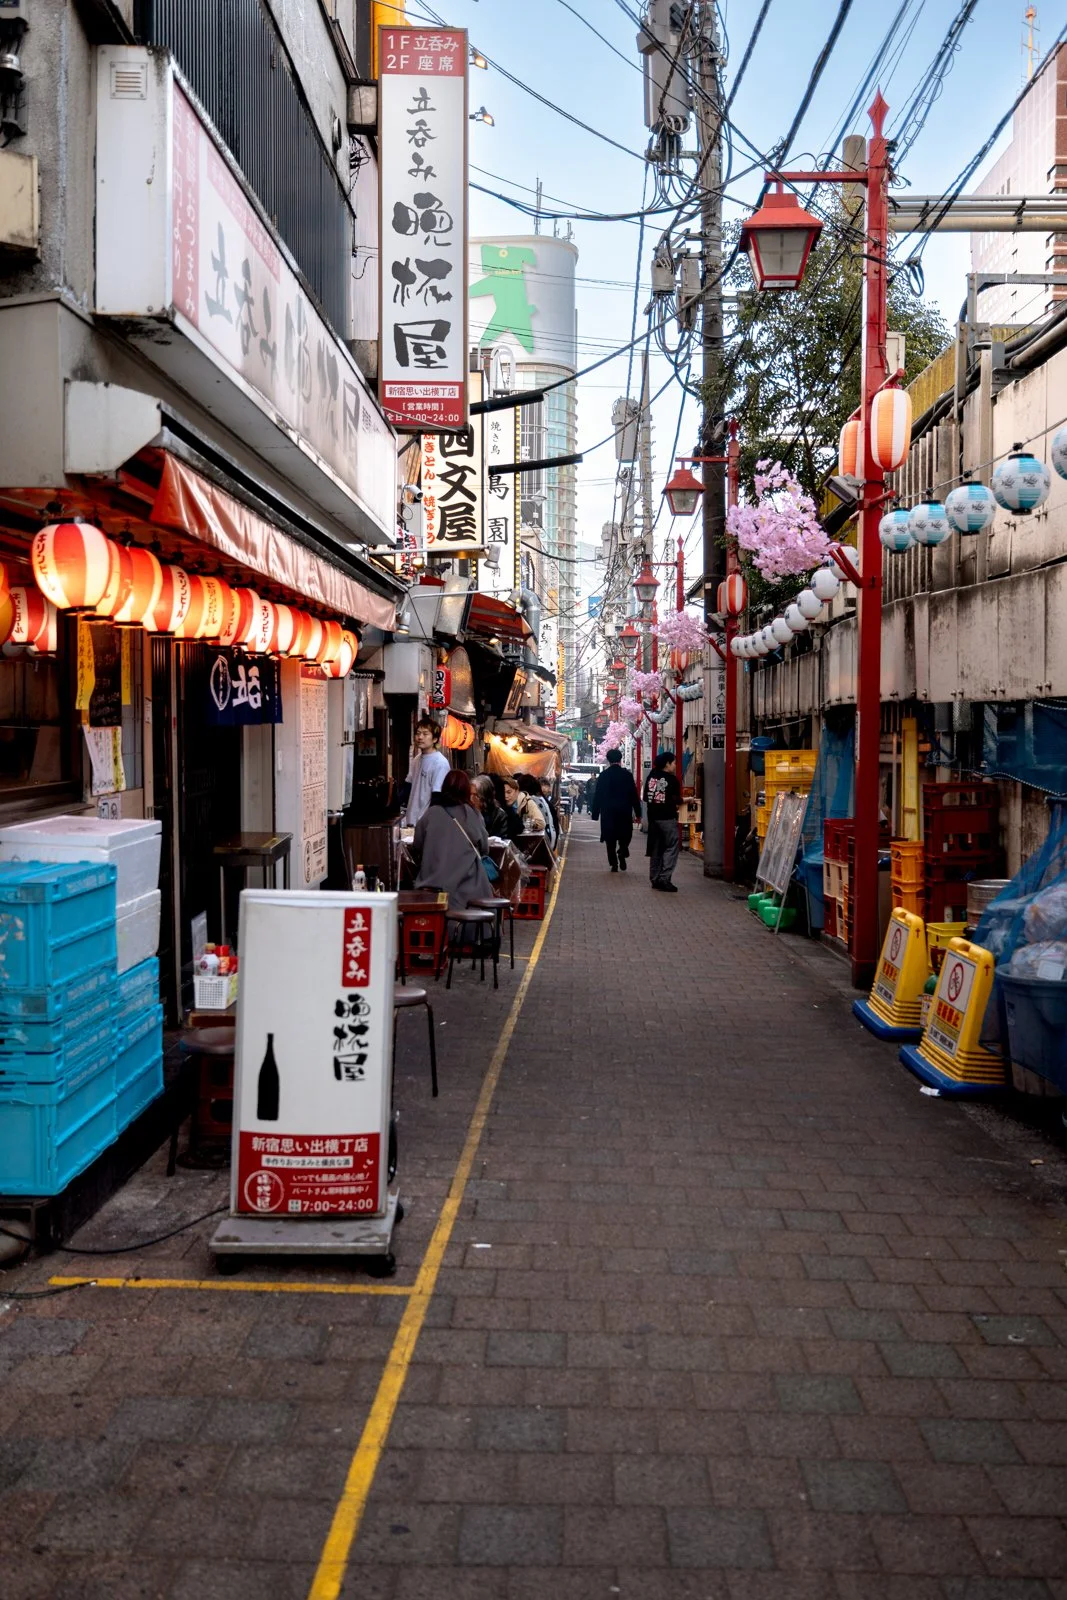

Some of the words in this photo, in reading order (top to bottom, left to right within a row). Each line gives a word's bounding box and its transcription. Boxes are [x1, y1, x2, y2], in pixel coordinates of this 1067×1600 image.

[386, 34, 410, 51] 1F
[413, 35, 459, 52] 立呑み
[386, 54, 410, 70] 2F
[417, 55, 454, 72] 座席
[405, 86, 437, 182] 立呑み
[391, 191, 454, 370] 晩杯屋
[387, 385, 458, 398] 新宿思い出横丁店
[490, 422, 502, 455] 焼き鳥
[436, 424, 477, 541] 四文屋
[260, 605, 270, 643] キリンビール
[345, 912, 369, 983] 立呑み
[332, 993, 372, 1082] 晩杯屋
[251, 1136, 369, 1154] 新宿思い出横丁店
